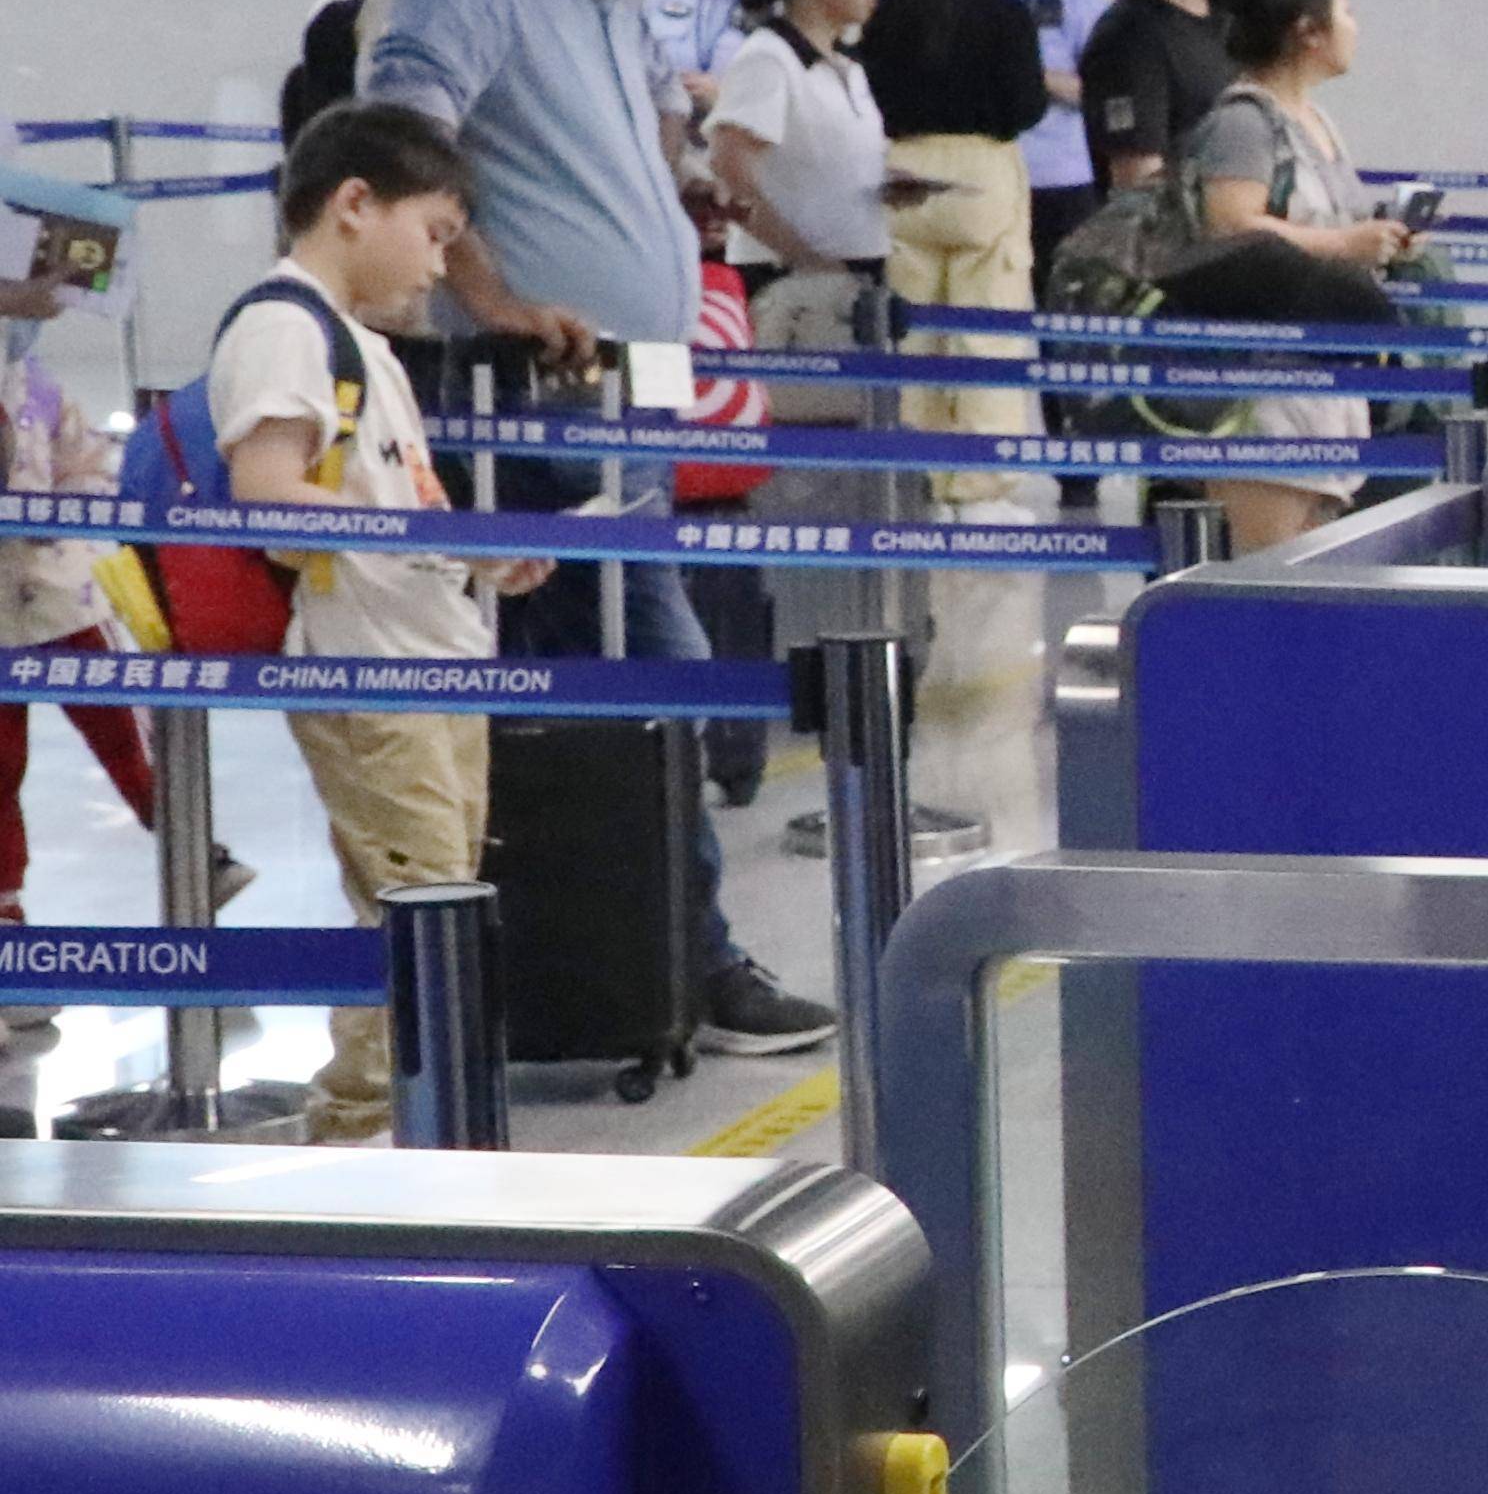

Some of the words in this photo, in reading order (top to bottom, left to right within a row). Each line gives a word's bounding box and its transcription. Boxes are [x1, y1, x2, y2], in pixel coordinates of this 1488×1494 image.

[564, 424, 628, 446] CHINA
[167, 506, 243, 531] CHINA
[247, 508, 407, 536] IMMIGRATION
[872, 529, 946, 552] CHINA
[951, 531, 1107, 554] IMMIGRATION
[10, 657, 230, 689] 中国移民管理
[258, 665, 348, 691] CHINA
[356, 665, 552, 693] IMMIGRATION
